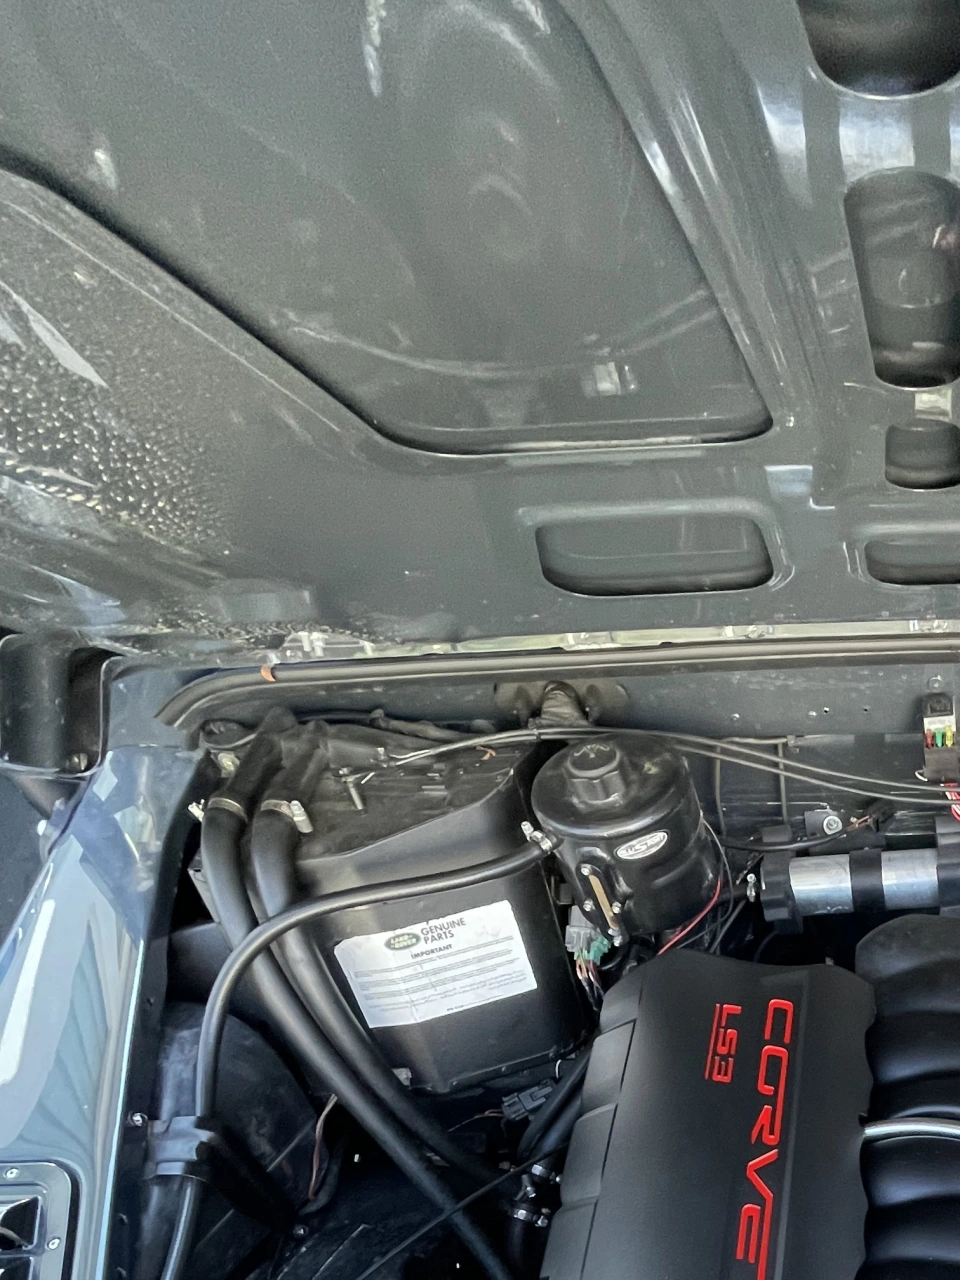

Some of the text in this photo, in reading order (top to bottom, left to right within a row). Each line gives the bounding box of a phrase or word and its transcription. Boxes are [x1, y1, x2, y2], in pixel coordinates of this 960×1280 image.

[420, 917, 466, 935] GENUINE
[390, 935, 410, 944] LAND
[423, 930, 455, 945] PARTS
[411, 943, 453, 960] IMPORTANT
[709, 1003, 742, 1083] LS3
